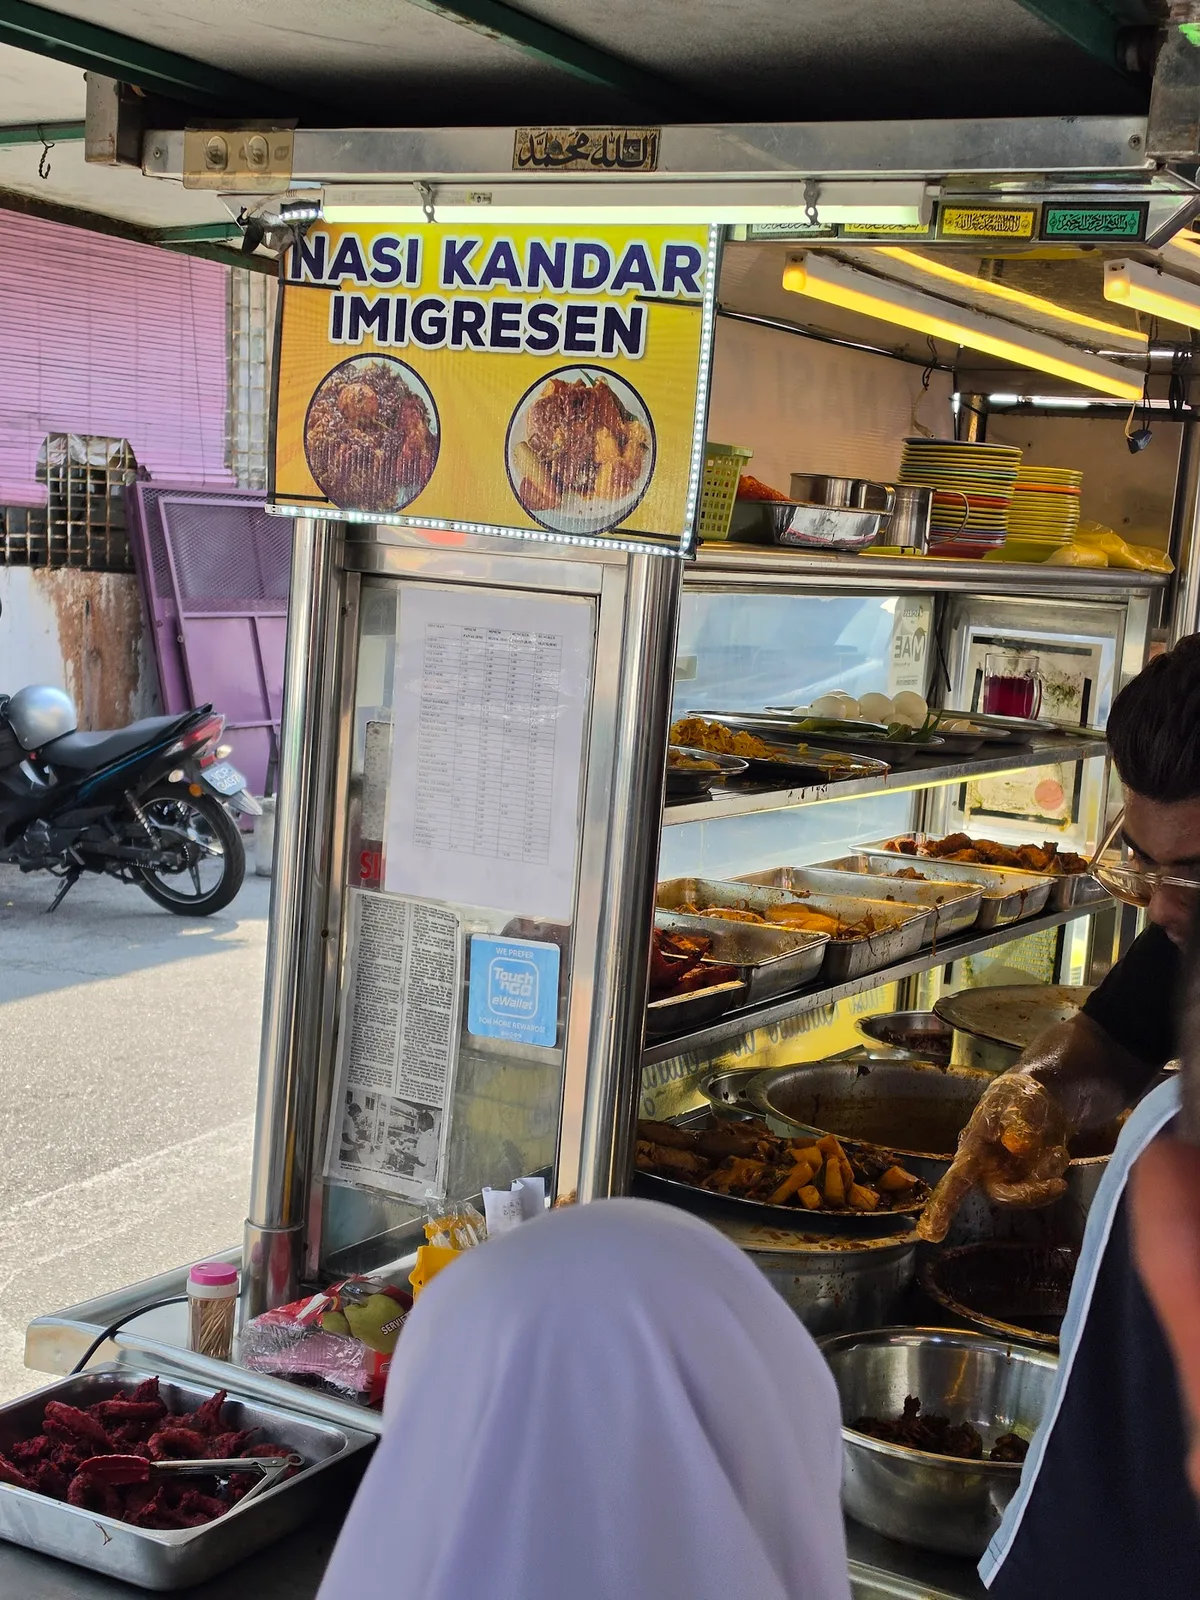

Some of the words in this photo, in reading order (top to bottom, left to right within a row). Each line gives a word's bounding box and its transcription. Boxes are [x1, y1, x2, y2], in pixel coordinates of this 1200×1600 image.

[290, 235, 419, 283] NASI
[443, 239, 702, 293] KANDAR
[331, 295, 643, 354] IMIGRESEN
[496, 947, 508, 956] WE
[508, 949, 534, 959] PREFER
[493, 966, 533, 985] Touch
[492, 996, 533, 1010] eWallet
[478, 1016, 492, 1025] FOR
[493, 1017, 511, 1028] MORE
